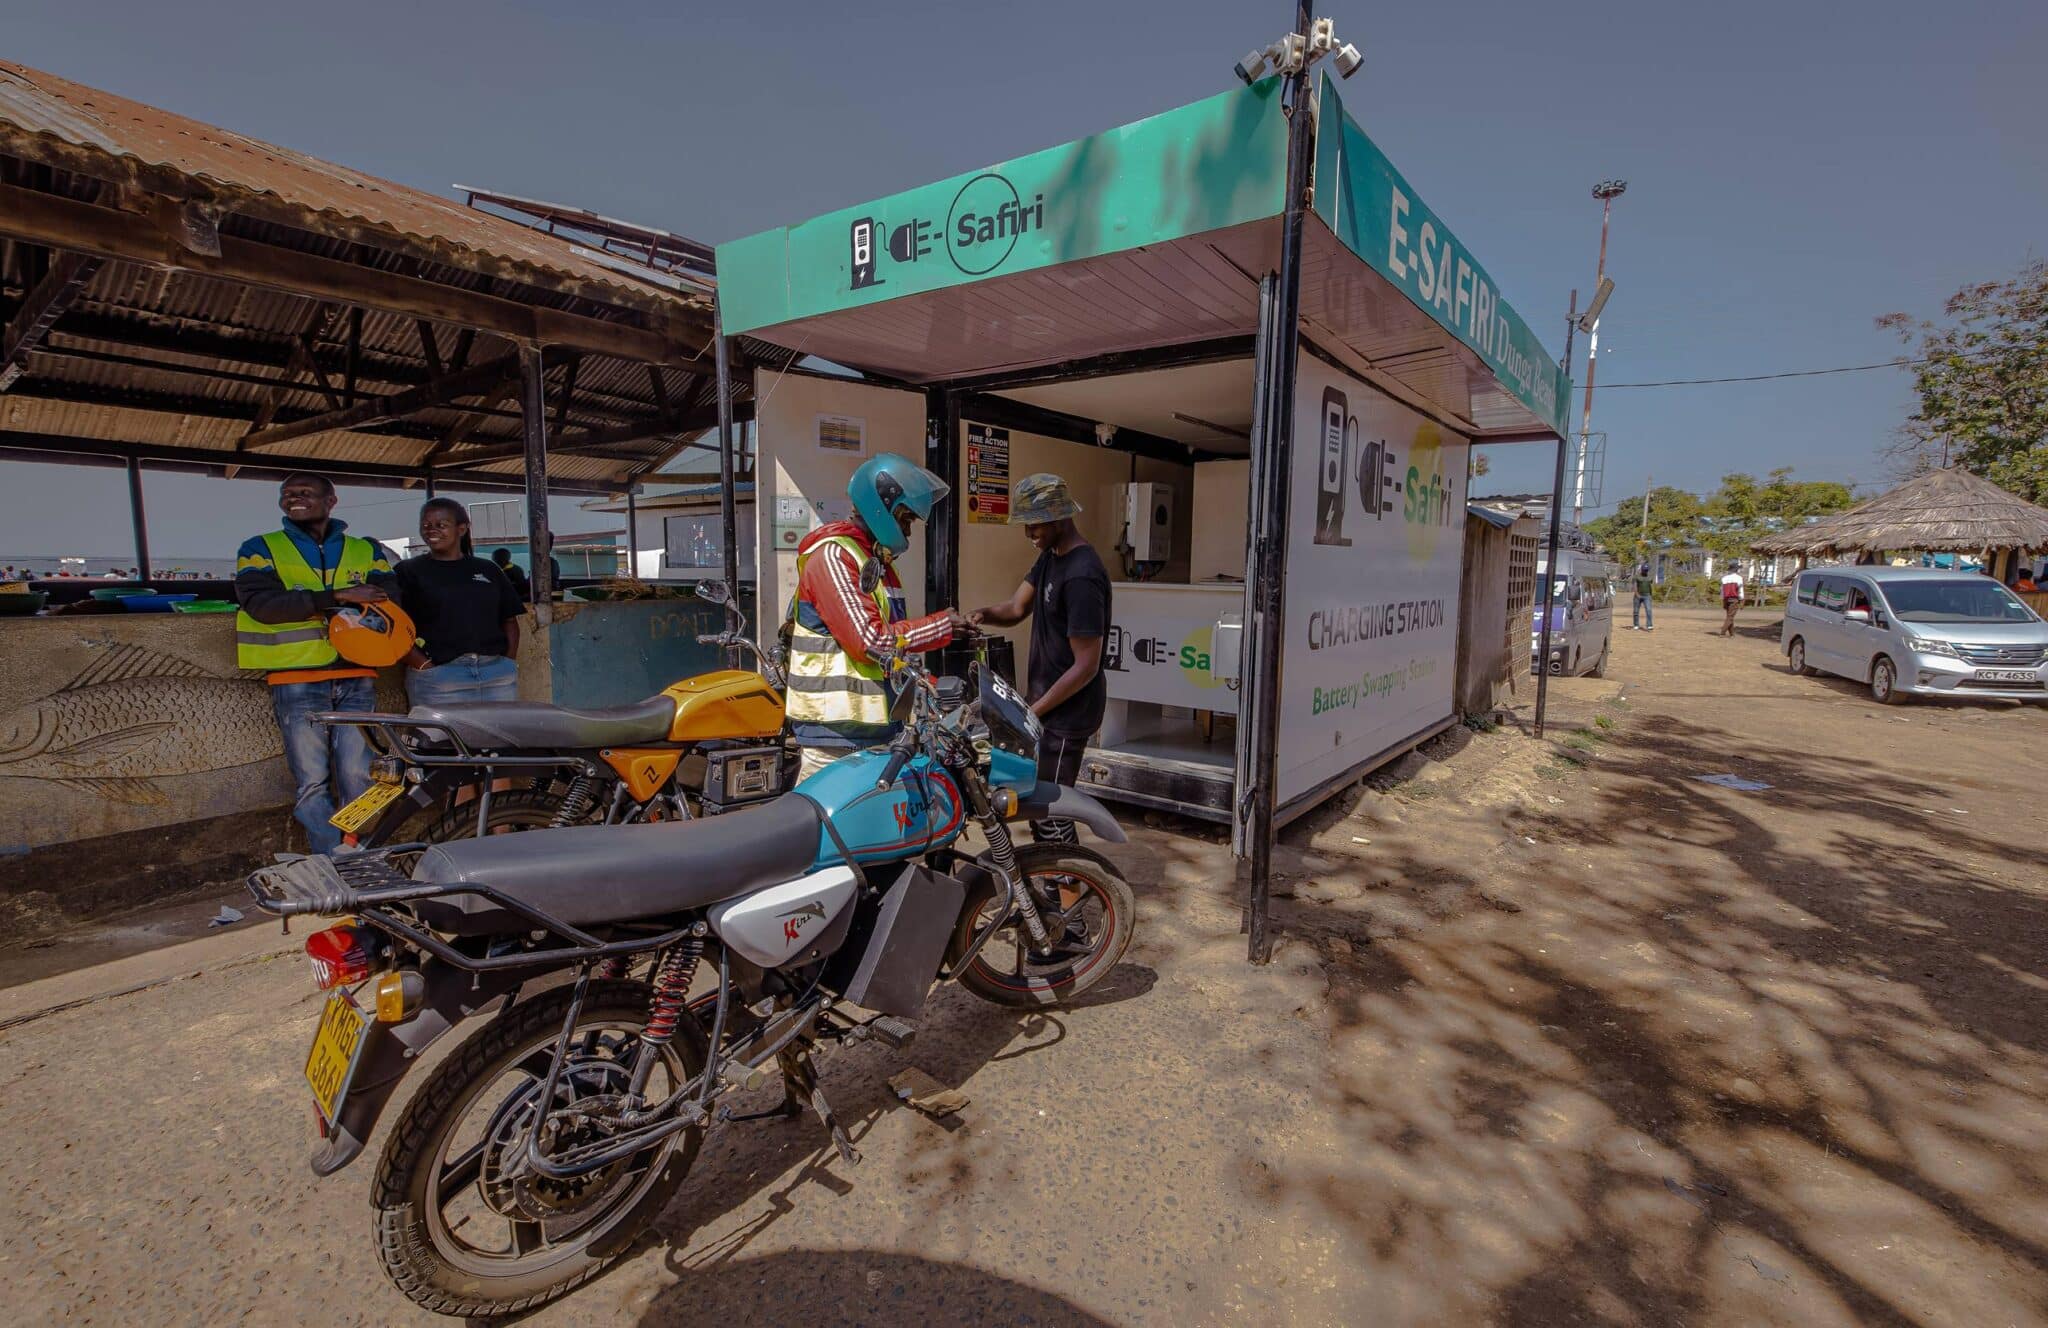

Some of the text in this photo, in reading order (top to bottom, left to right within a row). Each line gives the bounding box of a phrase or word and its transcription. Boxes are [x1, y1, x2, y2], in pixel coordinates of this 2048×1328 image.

[1388, 184, 1496, 357] E-SAFIRI
[1496, 315, 1533, 394] Dunga
[968, 434, 1008, 448] FIRE ACTION
[1308, 600, 1445, 651] CHARGING STATION
[1312, 687, 1360, 716] Battery
[1362, 664, 1408, 699] Swapping
[1978, 671, 1999, 680] KCY
